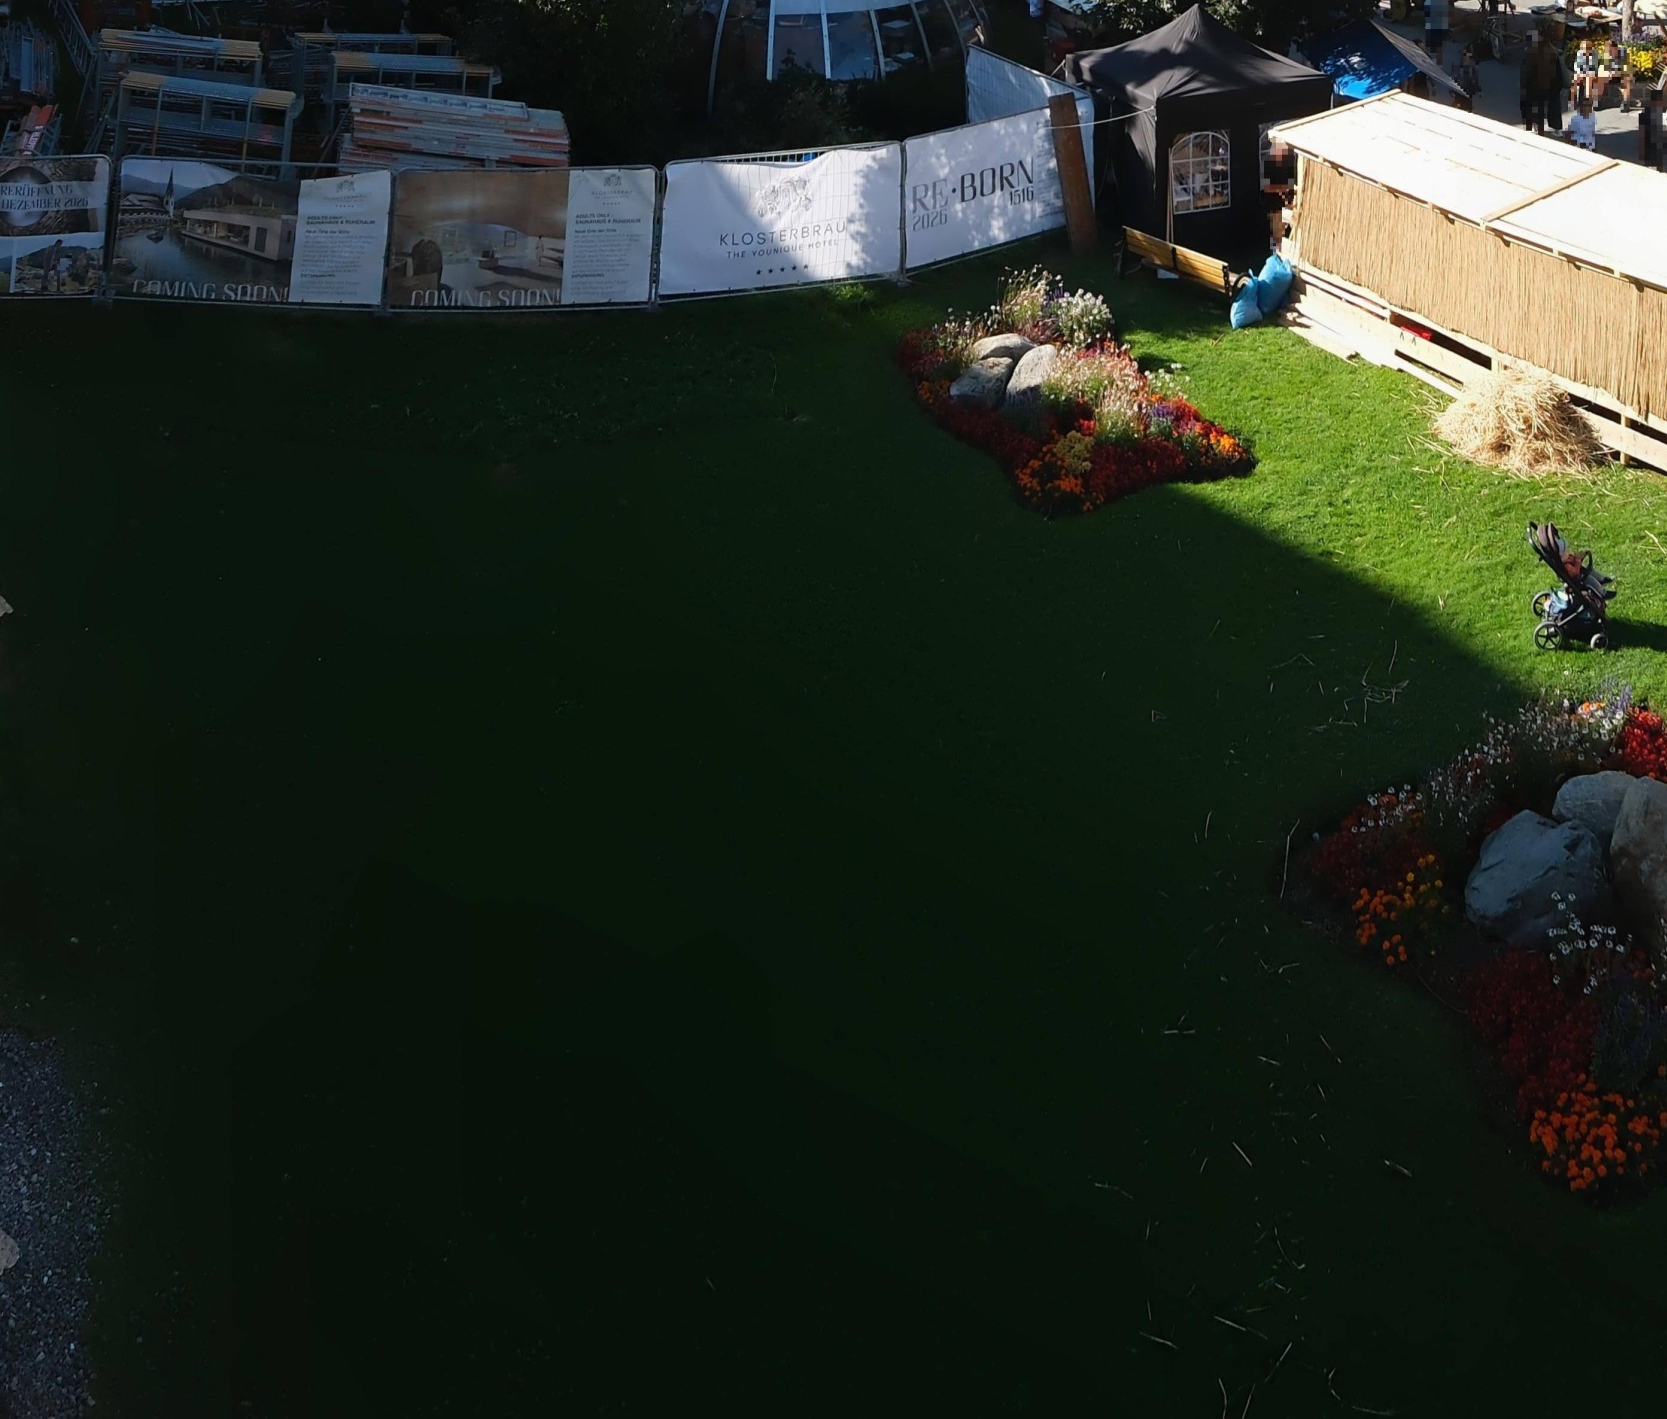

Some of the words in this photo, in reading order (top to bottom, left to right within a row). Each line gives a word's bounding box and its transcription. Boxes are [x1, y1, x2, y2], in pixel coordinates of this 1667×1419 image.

[1009, 188, 1034, 207] 1516
[912, 209, 948, 232] 2026
[719, 220, 847, 247] KLOSTERBRÄU
[727, 249, 746, 260] THE
[751, 243, 804, 258] YOUNIQUE
[808, 238, 839, 251] HOTEL
[132, 279, 217, 300] COMING
[223, 285, 288, 302] SOON!
[411, 289, 492, 306] COMING
[498, 288, 561, 306] SOON!
